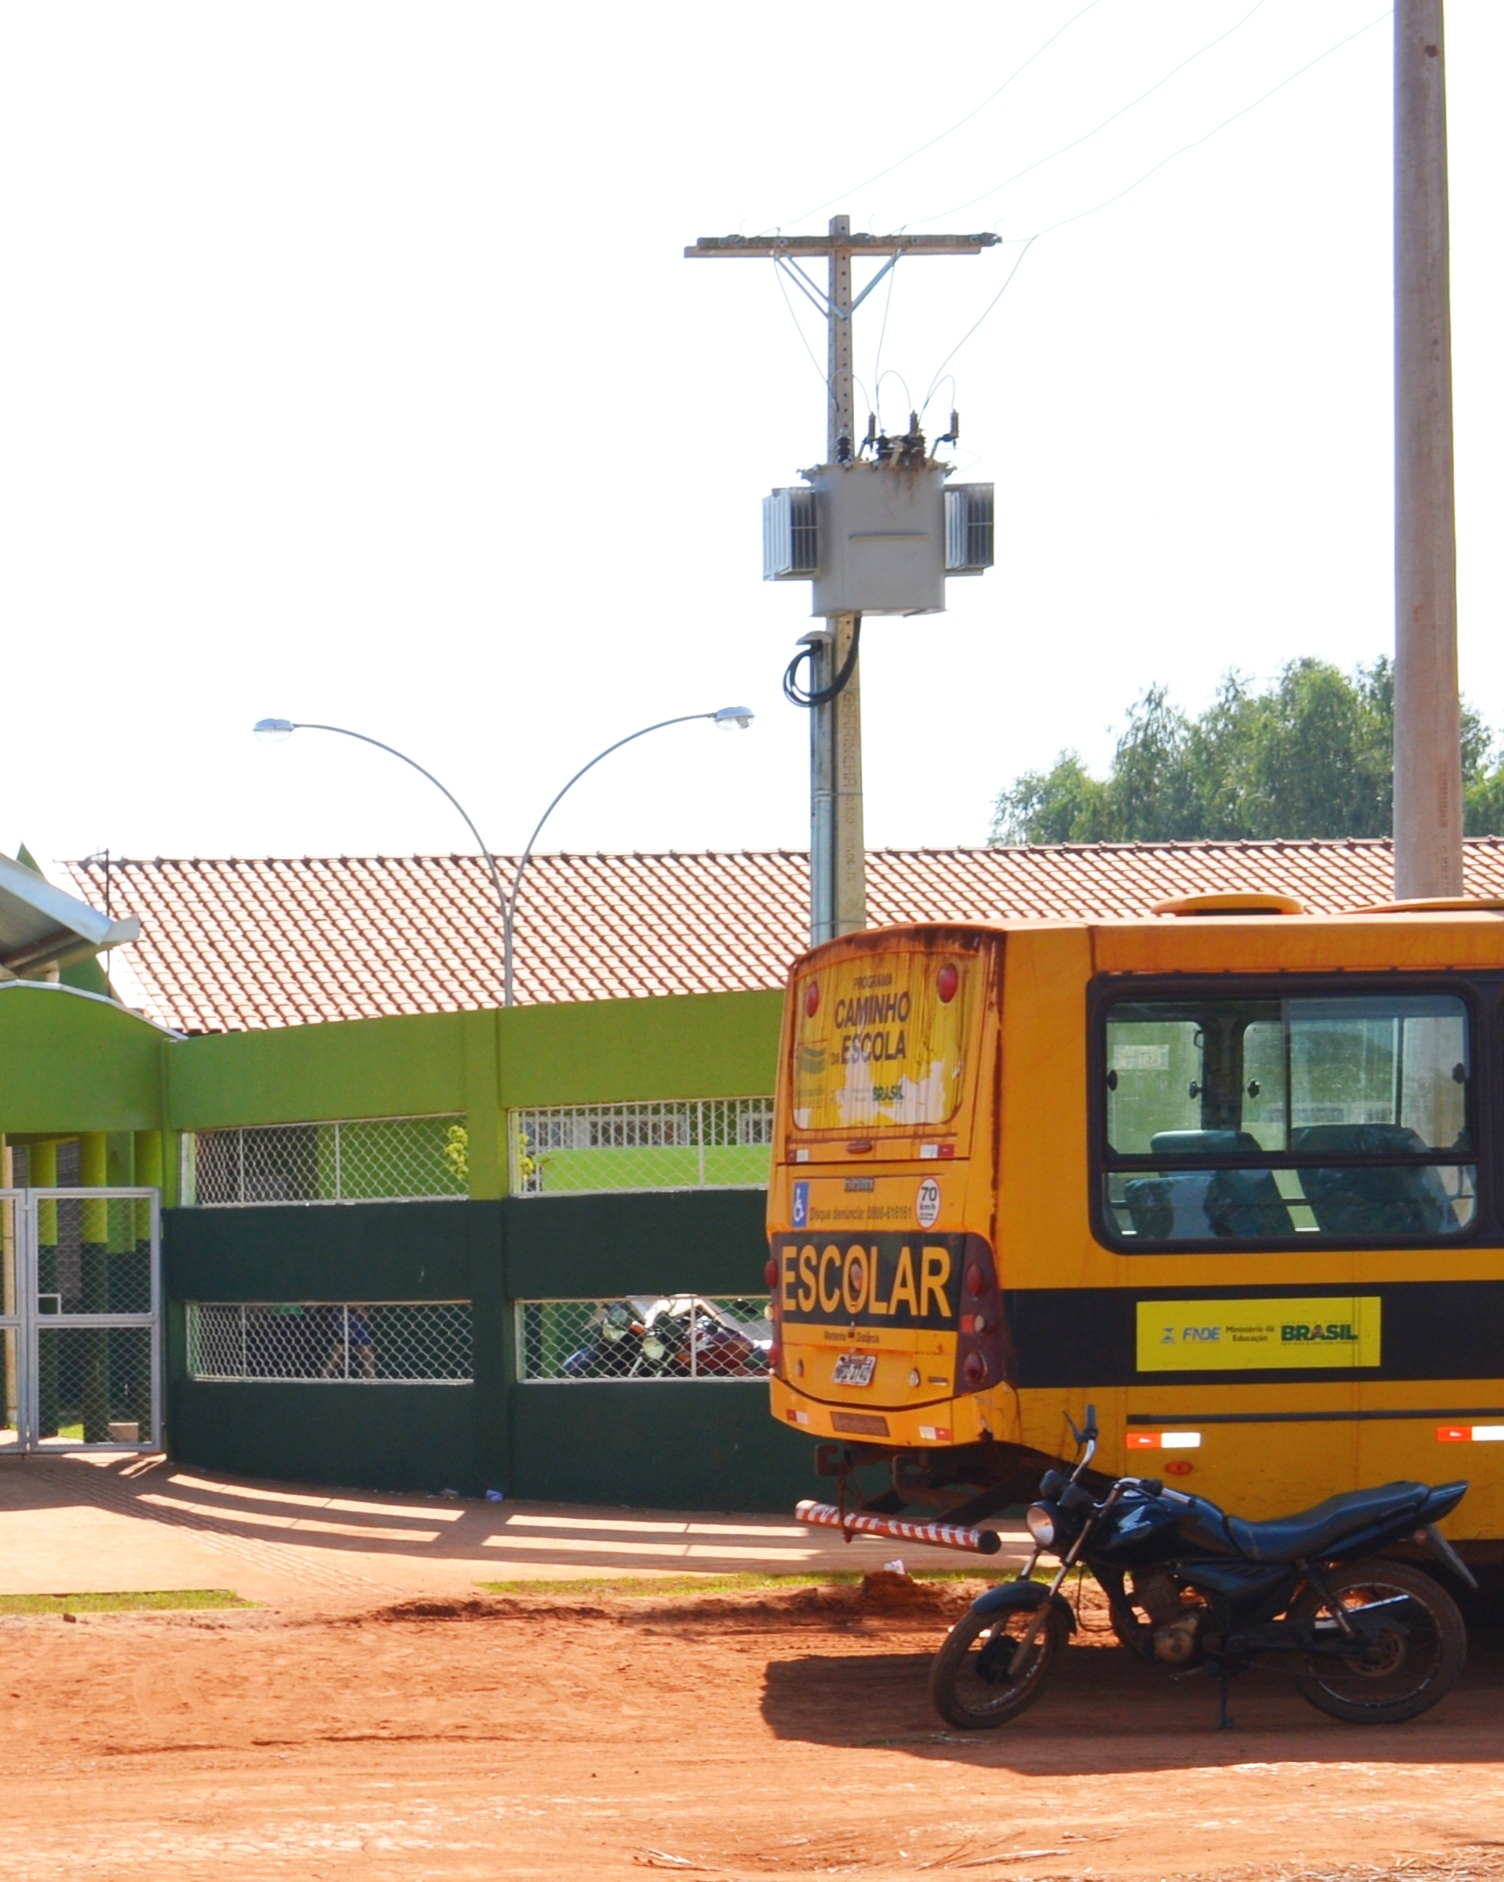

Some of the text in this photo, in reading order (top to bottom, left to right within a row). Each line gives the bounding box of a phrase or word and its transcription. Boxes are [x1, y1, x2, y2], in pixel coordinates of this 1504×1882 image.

[835, 991, 912, 1029] CAMINHO
[841, 1029, 906, 1065] ESCOLA
[872, 1084, 905, 1102] BRASIL
[921, 1186, 938, 1202] 70
[781, 1244, 953, 1317] ESCOLAR
[1182, 1326, 1222, 1341] FNDE
[1281, 1324, 1359, 1341] BRASIL
